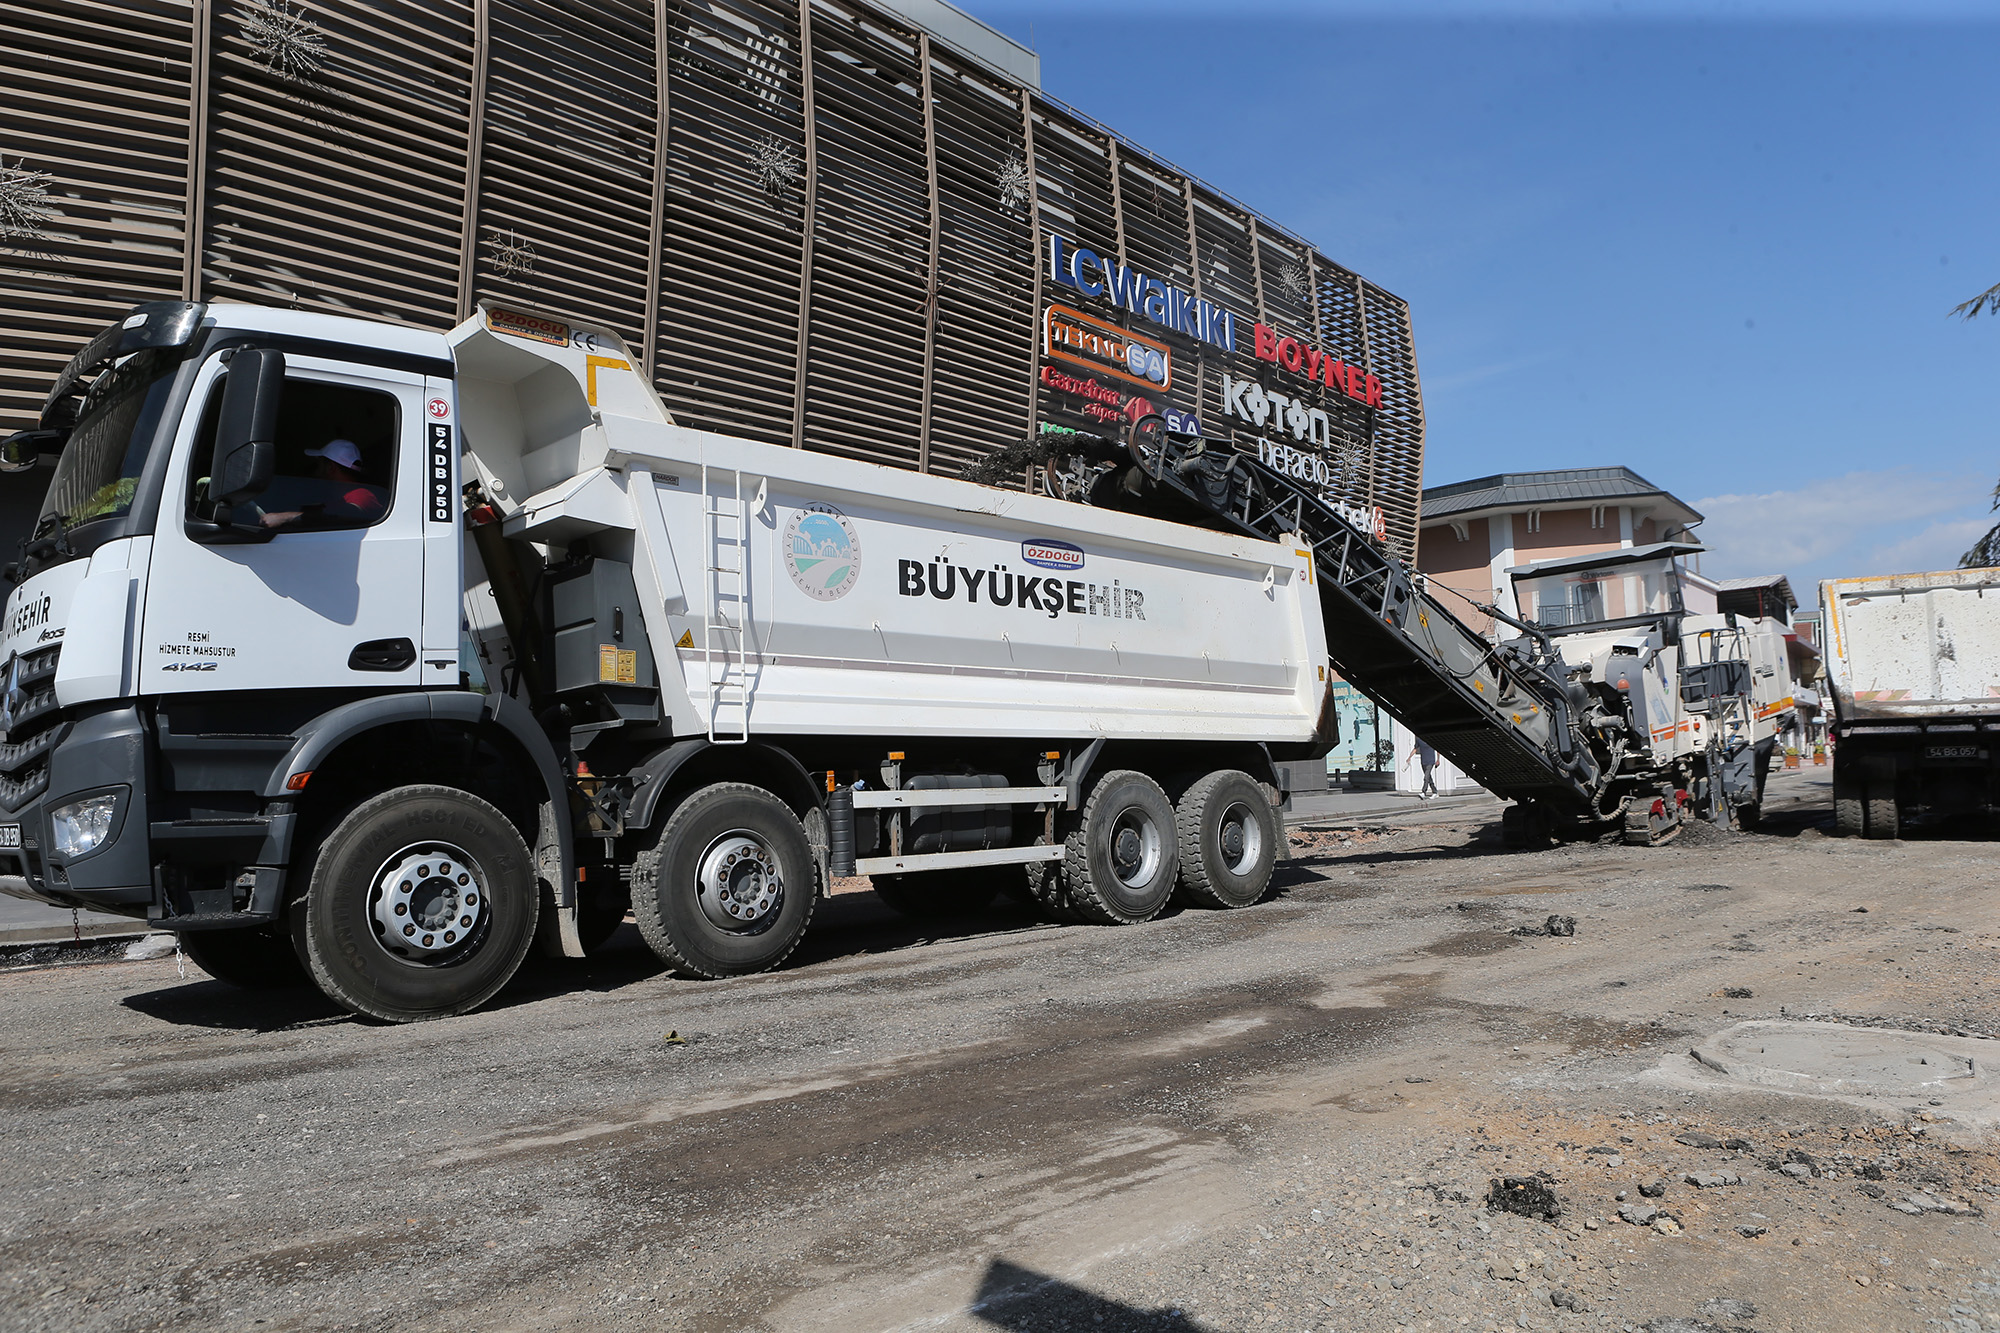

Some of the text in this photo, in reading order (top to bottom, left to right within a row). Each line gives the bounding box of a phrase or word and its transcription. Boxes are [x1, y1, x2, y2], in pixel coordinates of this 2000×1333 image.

[1051, 320, 1164, 382] TEKNOSA
[1254, 322, 1384, 410] BOYNER
[1041, 365, 1121, 407] Carrefour
[429, 402, 447, 415] 39
[1084, 402, 1121, 424] süper
[1168, 416, 1200, 436] SA
[1258, 437, 1330, 487] DeFacto
[434, 426, 447, 520] 54 DB 950
[1027, 546, 1080, 562] ÖZDOĞU
[898, 555, 1147, 621] BÜYÜKŞEHİR
[187, 630, 210, 643] RESMİ
[159, 641, 236, 657] HİZMETE MAHSUSTUR
[161, 661, 218, 672] 4142
[1959, 747, 1977, 756] 057
